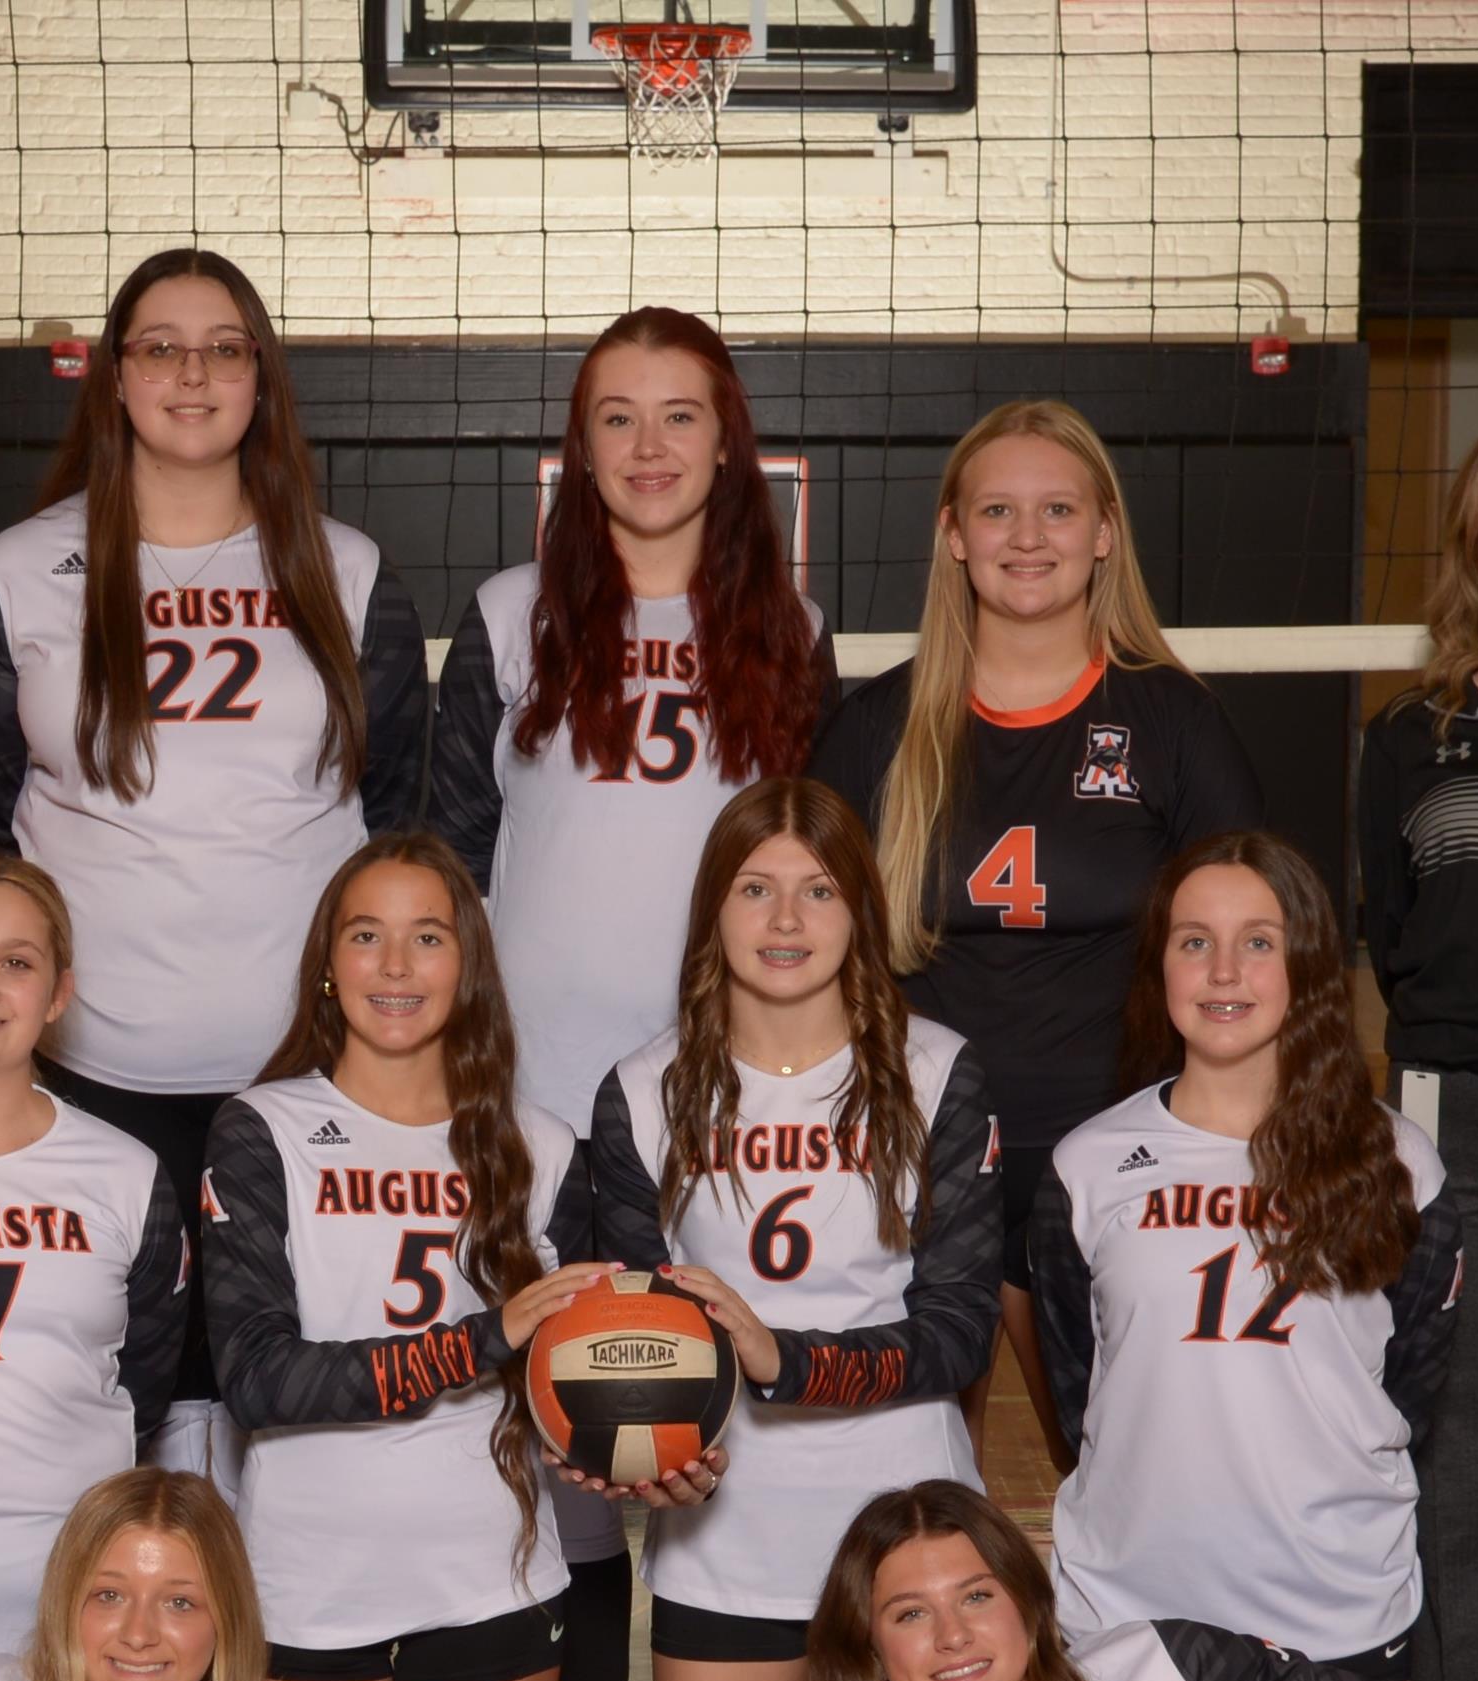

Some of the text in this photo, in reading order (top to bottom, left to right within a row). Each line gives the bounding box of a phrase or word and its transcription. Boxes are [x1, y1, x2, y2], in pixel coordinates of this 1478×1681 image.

[145, 587, 293, 629] GUSTA
[144, 637, 263, 723] 22
[587, 690, 707, 785] 15
[967, 825, 1046, 928] 4
[307, 1135, 350, 1145] adidas
[1117, 1158, 1159, 1174] adidas
[315, 1168, 470, 1219] AUGUS
[749, 1184, 815, 1283] 6
[383, 1228, 459, 1330] 5
[1179, 1242, 1297, 1346] 12
[587, 1339, 677, 1366] TACHIKARA
